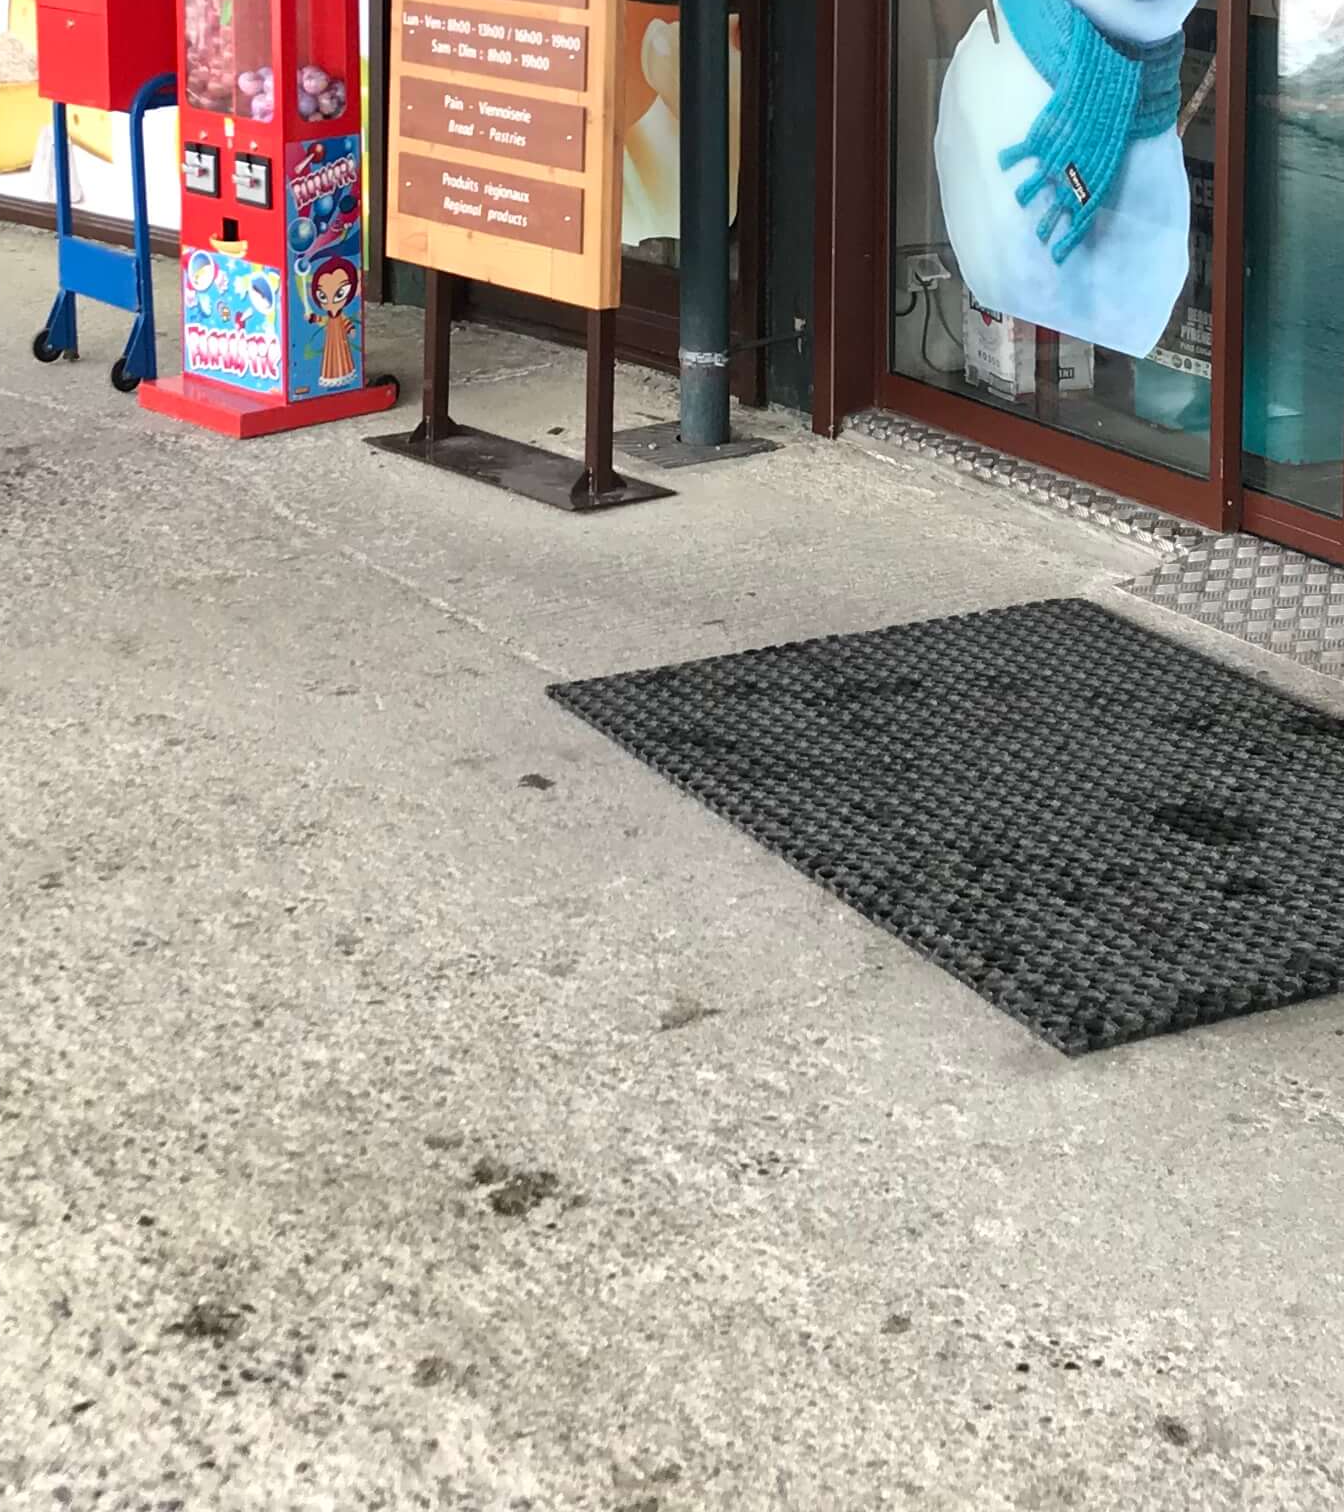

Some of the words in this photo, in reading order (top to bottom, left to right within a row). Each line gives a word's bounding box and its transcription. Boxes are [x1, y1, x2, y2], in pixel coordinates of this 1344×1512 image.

[403, 12, 419, 26] Lun
[478, 23, 505, 40] 13h00
[514, 28, 543, 46] 16h00
[551, 34, 581, 51] 19h00
[431, 39, 451, 55] Sam
[521, 54, 550, 71] 19h00
[444, 94, 464, 111] Pain
[448, 119, 475, 136] Bread
[489, 127, 527, 147] Pastries
[442, 172, 479, 193] Produits
[443, 196, 482, 217] Regional
[487, 208, 528, 227] products
